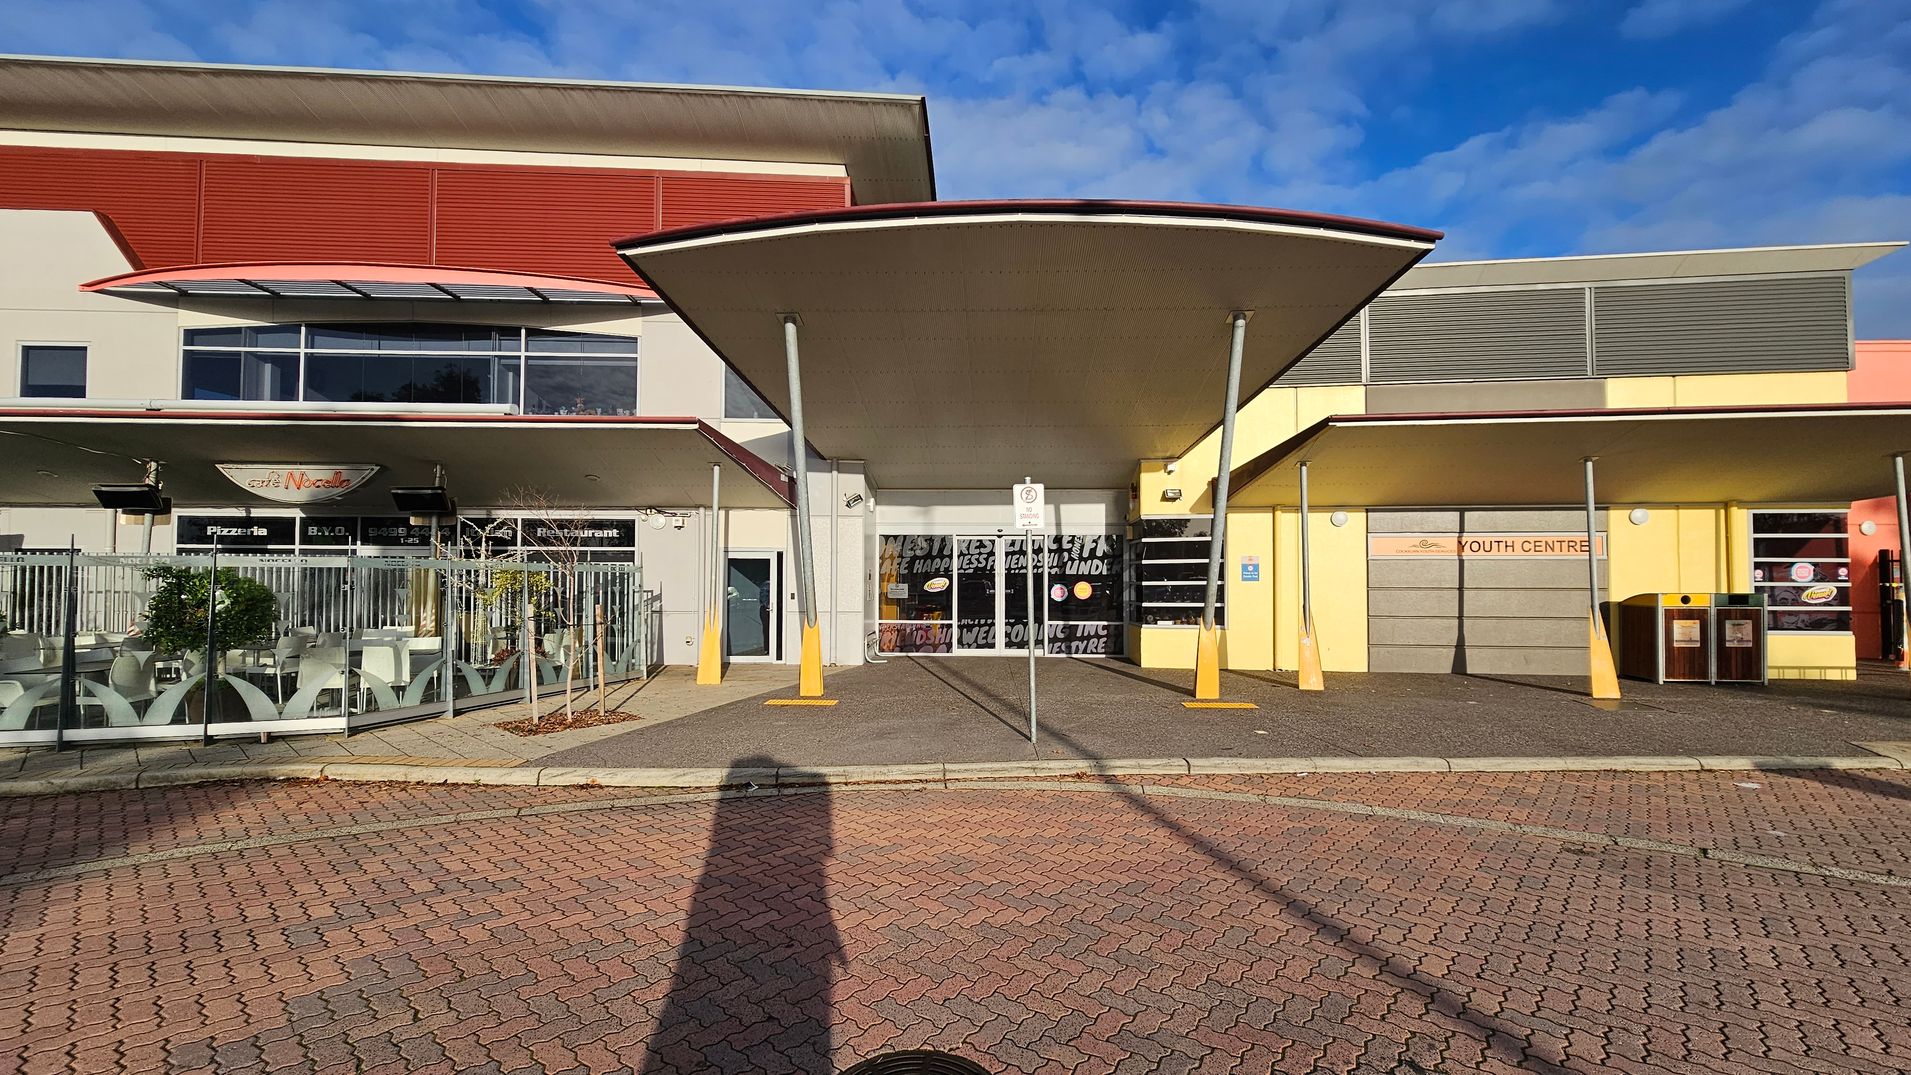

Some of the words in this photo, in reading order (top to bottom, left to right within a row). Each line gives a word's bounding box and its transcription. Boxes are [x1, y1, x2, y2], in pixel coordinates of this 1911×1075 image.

[206, 525, 268, 536] Pizzeria
[307, 526, 350, 536] B.Y.O.
[368, 527, 408, 537] 9499
[410, 527, 451, 537] 444
[465, 527, 513, 537] Itian
[536, 527, 620, 538] Restaurant
[1457, 540, 1516, 553] YOUTH
[1520, 540, 1590, 553] CENTRE
[986, 551, 1069, 571] FIENDSHIP
